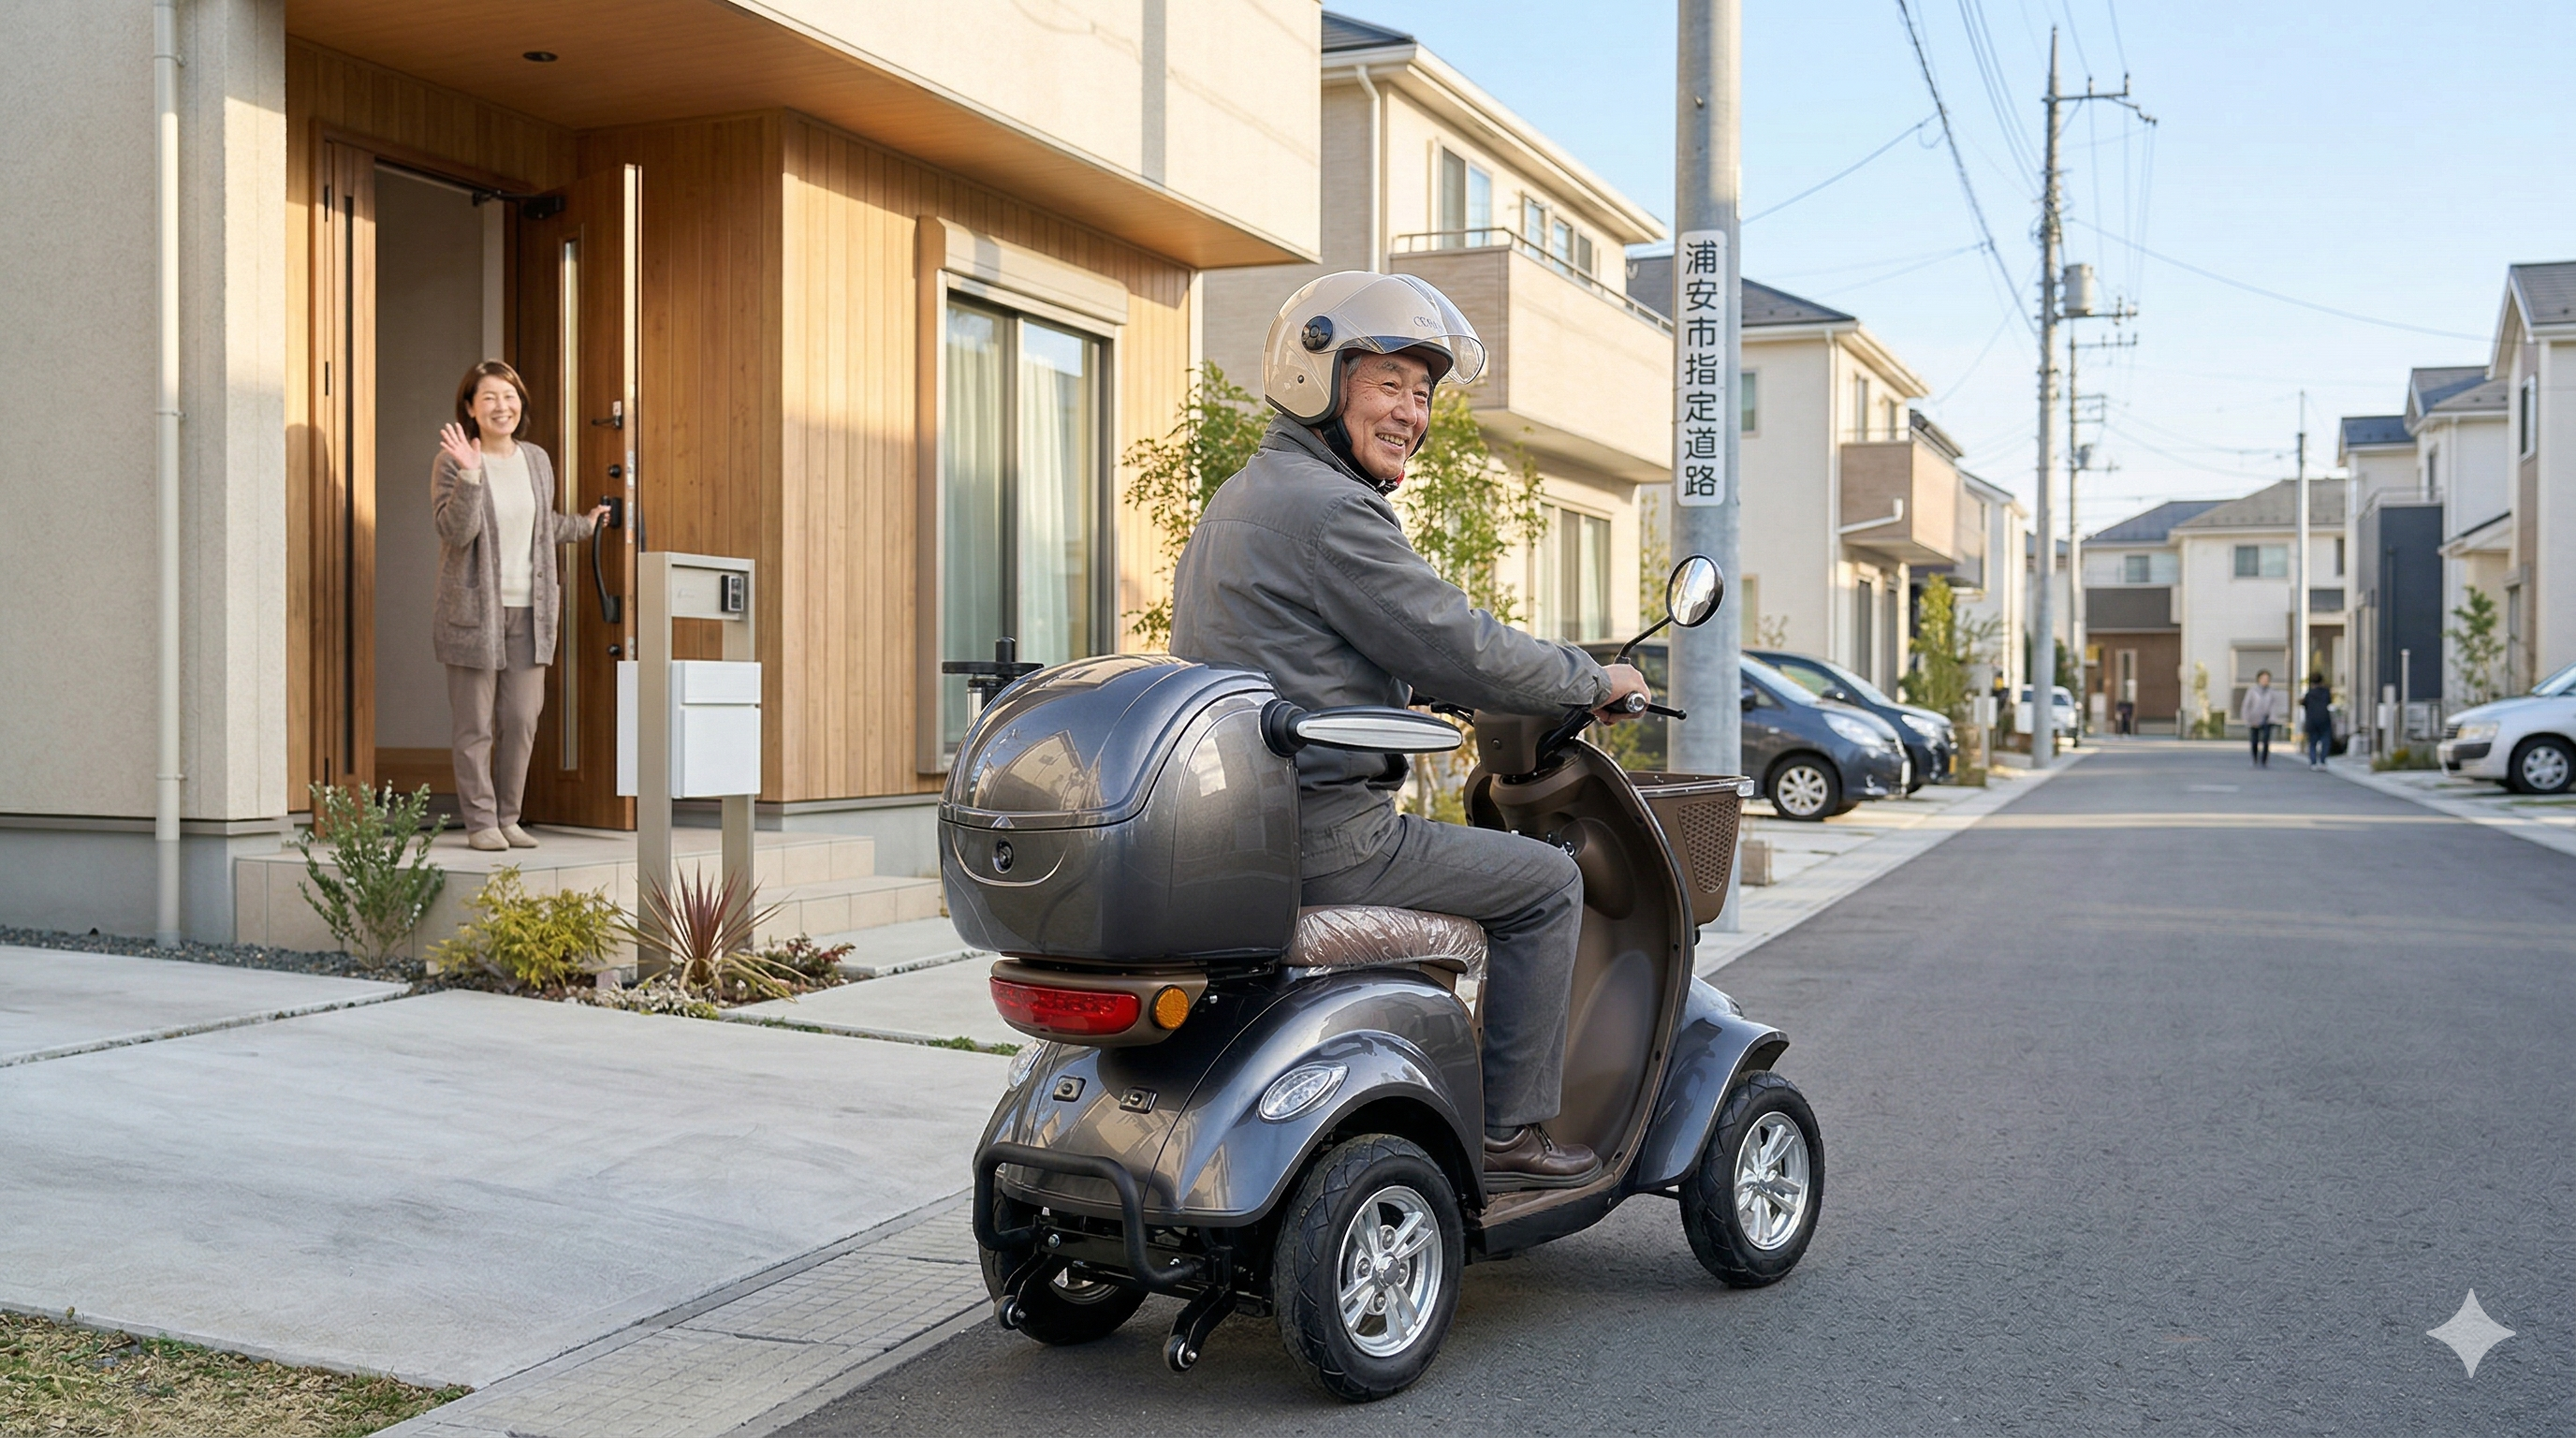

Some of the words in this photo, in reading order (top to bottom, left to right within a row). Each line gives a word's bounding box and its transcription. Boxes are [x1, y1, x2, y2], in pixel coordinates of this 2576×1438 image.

[1684, 240, 1718, 497] 浦安市指定道路
